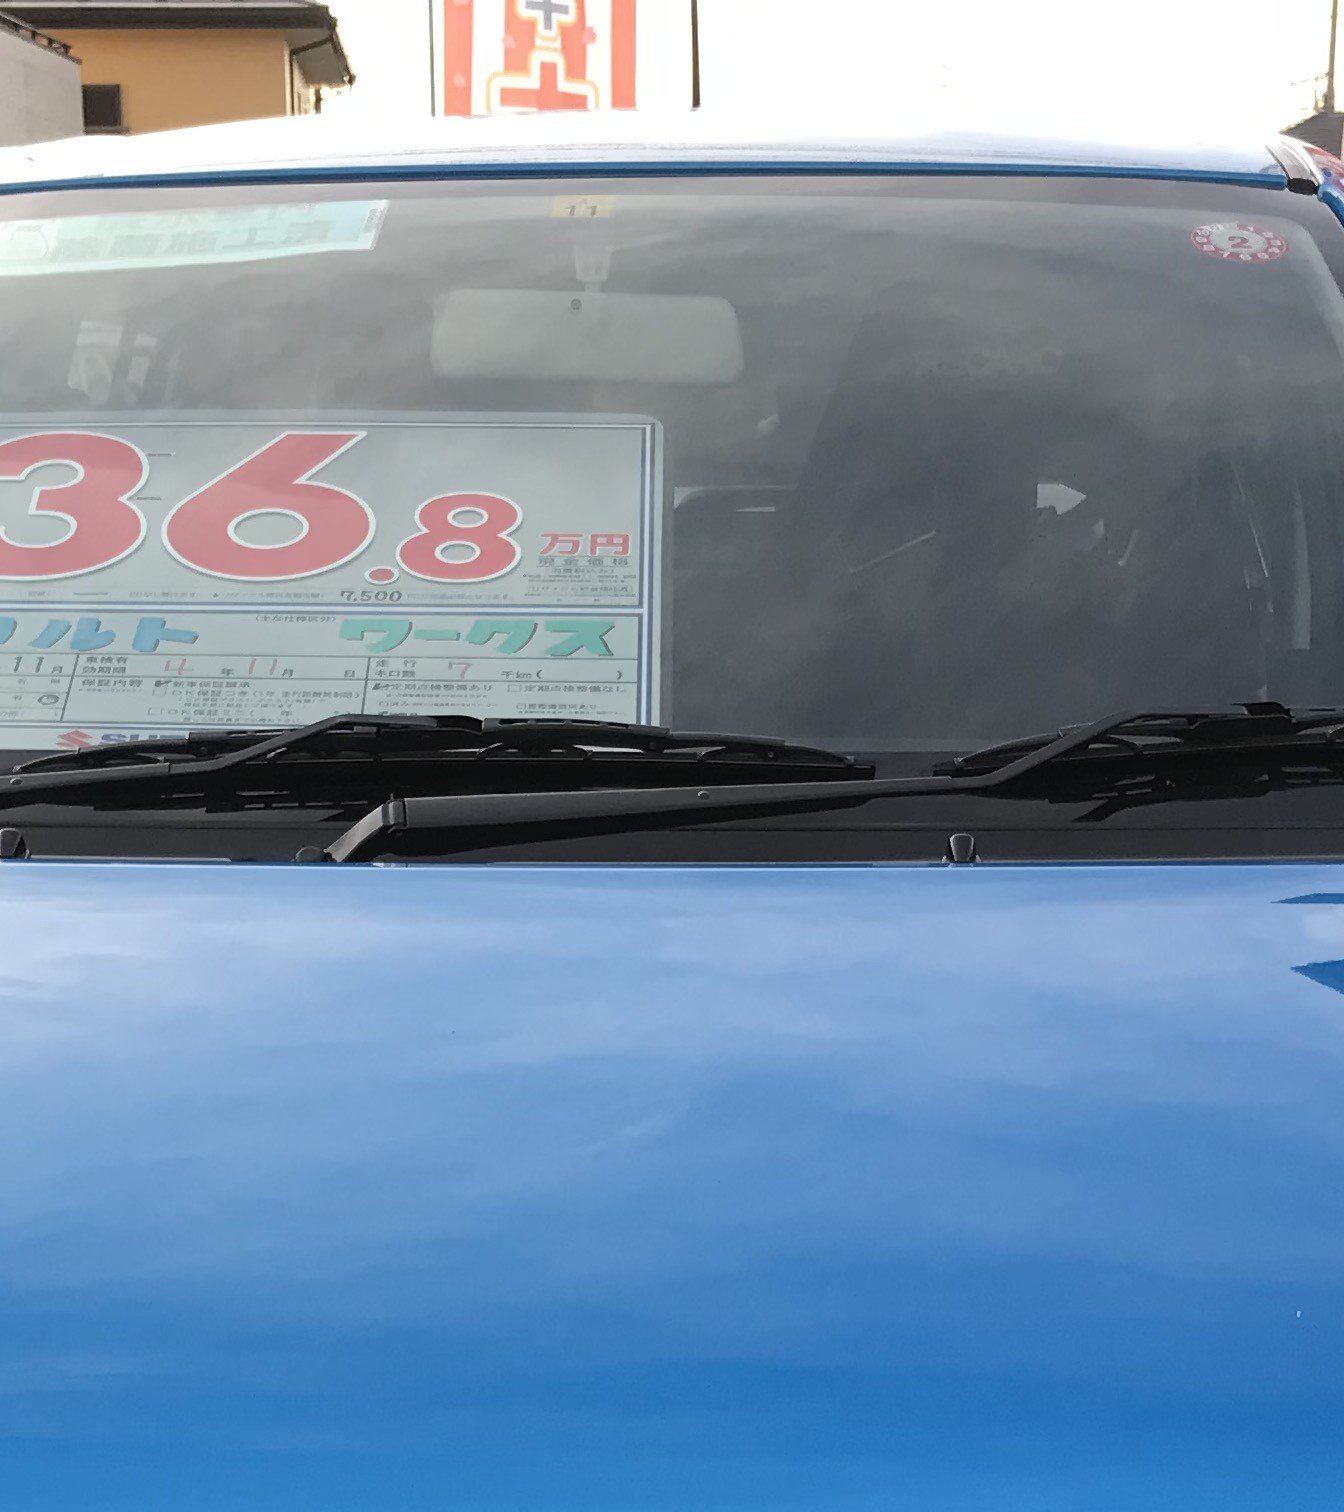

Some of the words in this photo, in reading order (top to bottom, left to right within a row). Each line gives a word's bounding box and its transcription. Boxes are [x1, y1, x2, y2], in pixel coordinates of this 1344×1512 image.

[1227, 236, 1253, 250] 2
[539, 532, 632, 557] 万円
[339, 617, 617, 657] ワークス
[50, 665, 64, 675] 月
[220, 667, 234, 676] 年
[281, 667, 295, 678] 月
